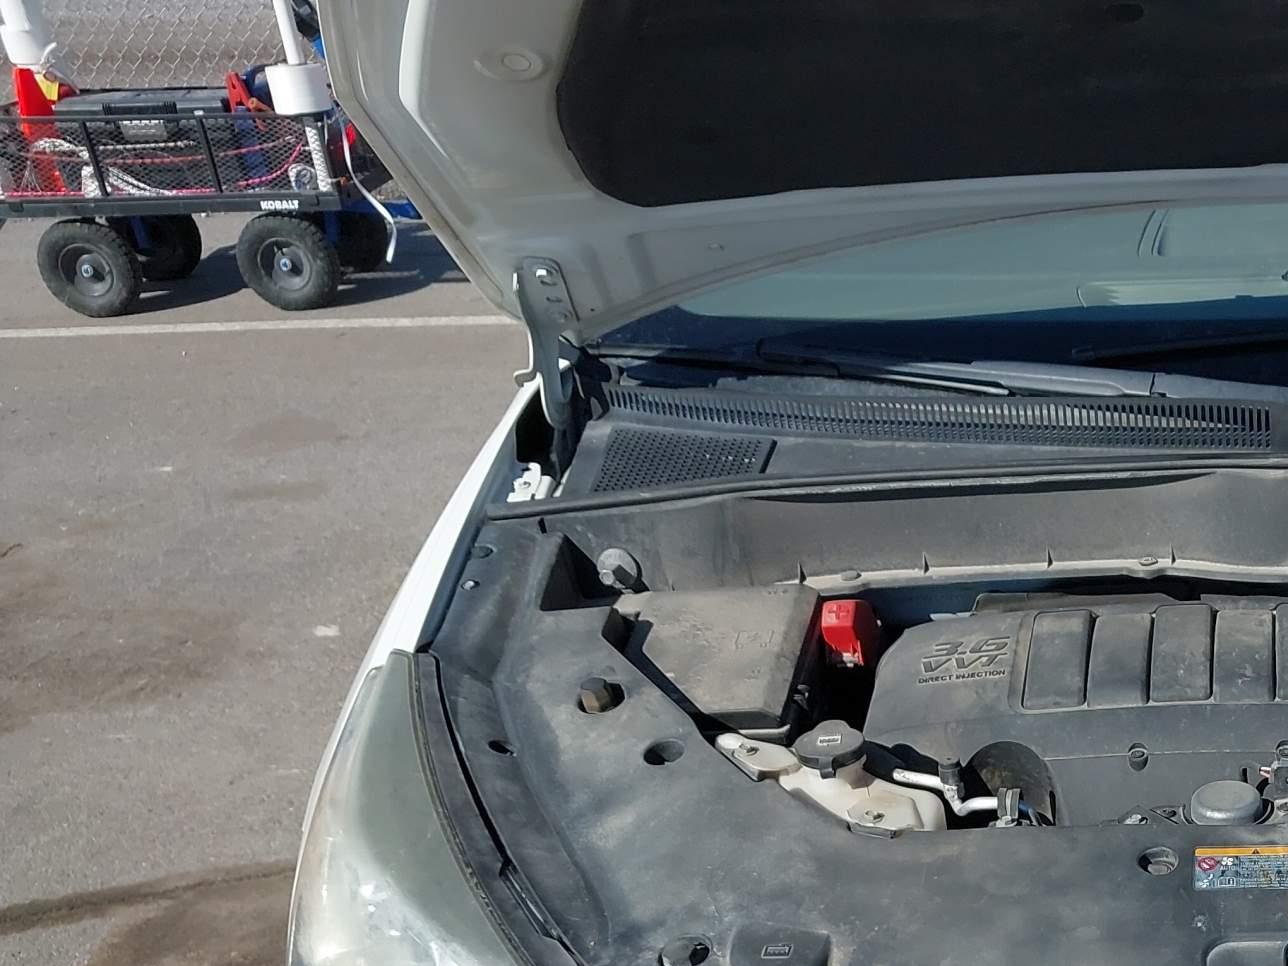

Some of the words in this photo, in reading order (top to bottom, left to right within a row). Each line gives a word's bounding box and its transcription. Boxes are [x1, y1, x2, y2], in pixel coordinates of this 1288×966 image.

[260, 200, 299, 210] KOBALT
[922, 636, 1010, 659] 3.6
[923, 653, 1008, 674] VVT
[918, 675, 954, 684] DIRECT
[955, 669, 1006, 681] INJECTION
